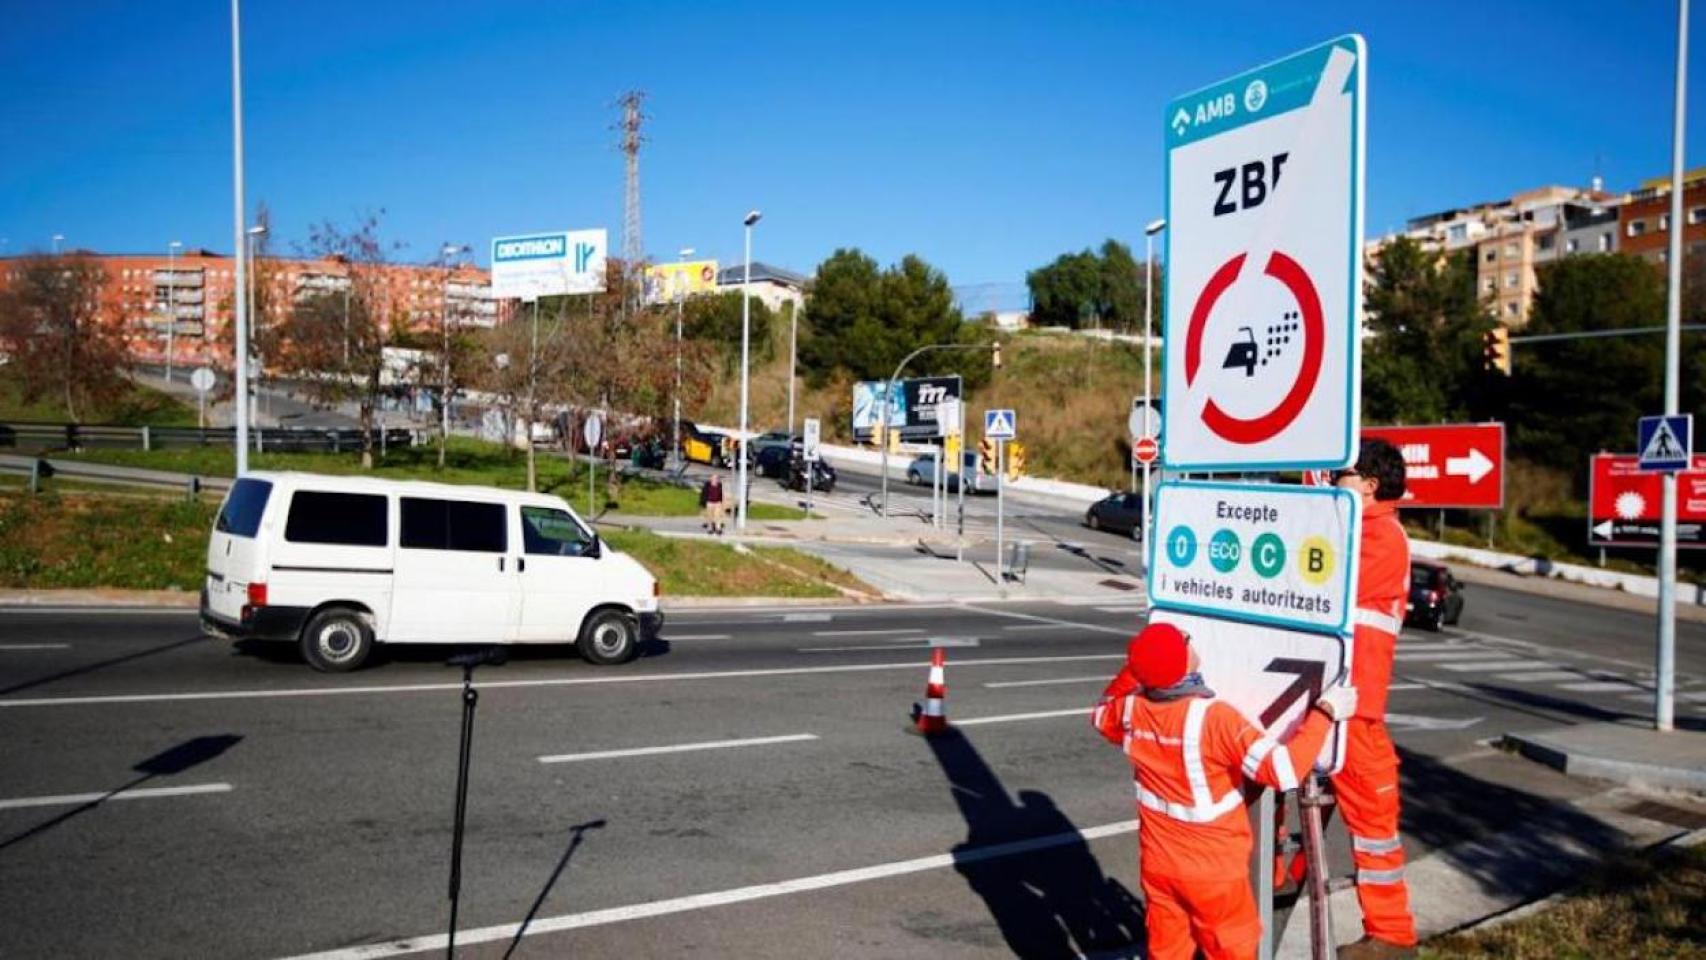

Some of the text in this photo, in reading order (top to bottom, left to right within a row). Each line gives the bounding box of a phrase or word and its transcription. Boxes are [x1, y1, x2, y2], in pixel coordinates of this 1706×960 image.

[1195, 93, 1236, 127] AMB
[497, 238, 563, 259] DECATHLON
[1216, 501, 1278, 523] Excepte
[1210, 541, 1240, 561] ECO
[1259, 541, 1277, 569] C
[1307, 548, 1324, 573] B
[1242, 588, 1331, 614] autoritzats
